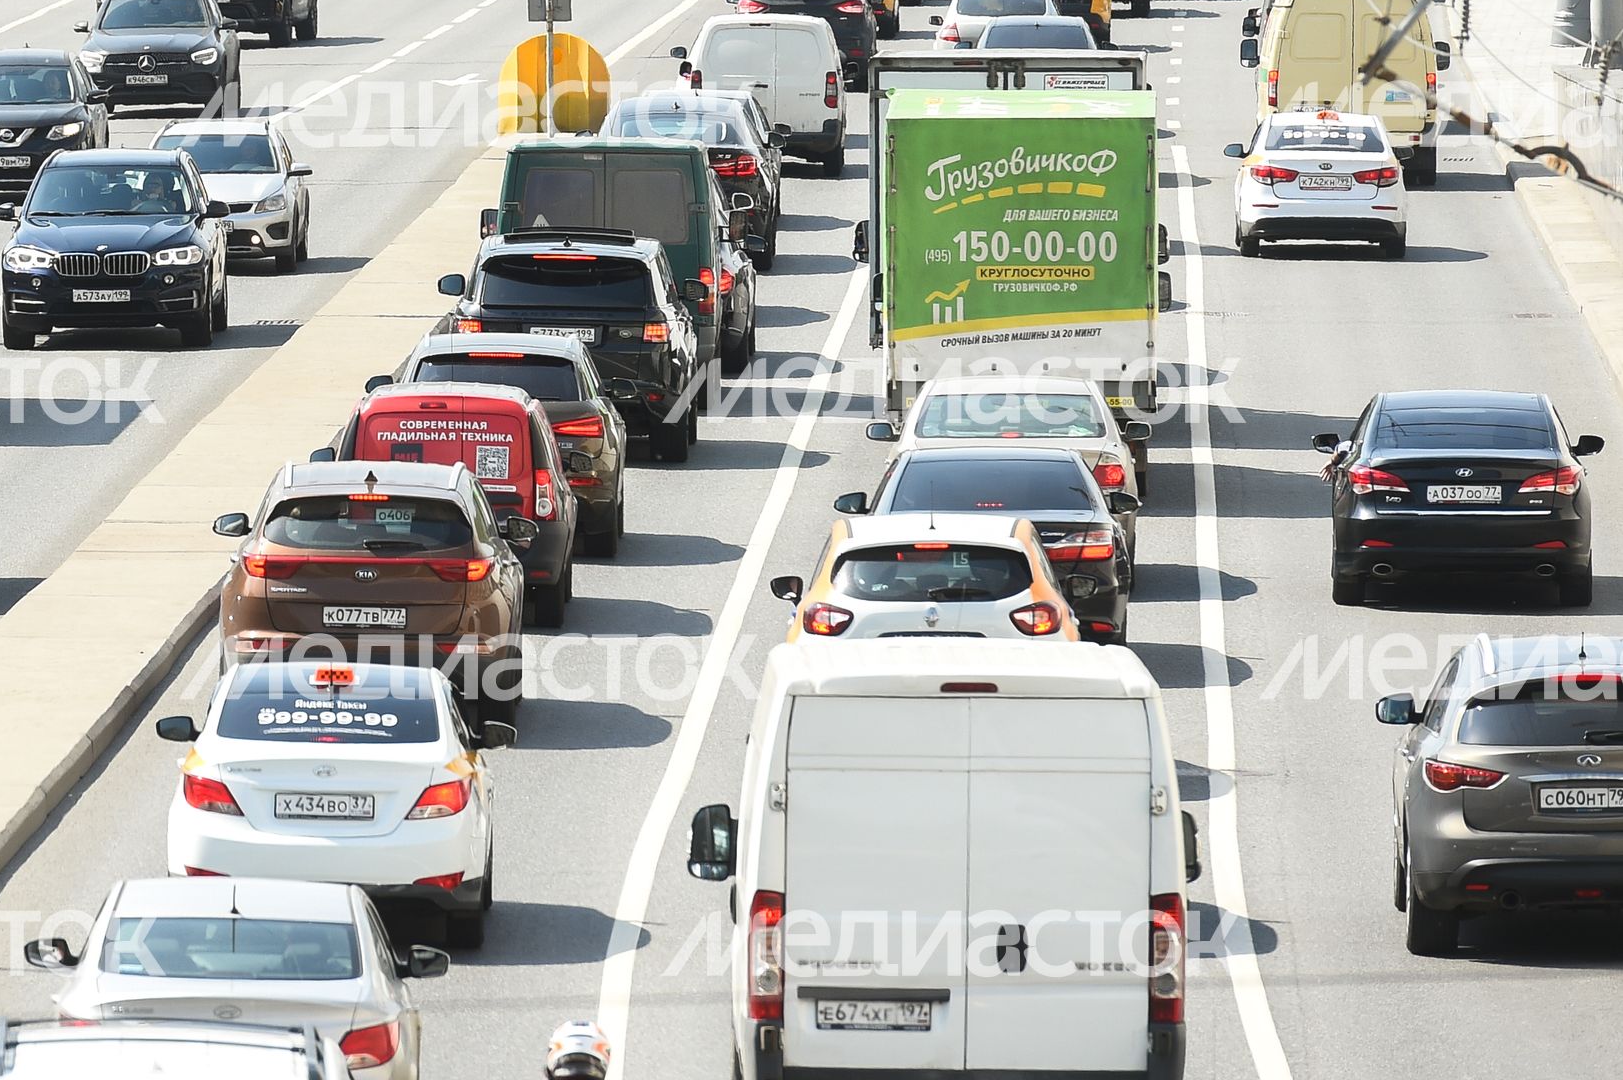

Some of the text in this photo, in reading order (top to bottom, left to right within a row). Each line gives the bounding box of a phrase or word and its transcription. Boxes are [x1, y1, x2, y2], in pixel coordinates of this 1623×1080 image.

[1003, 209, 1119, 223] ДЛЯ ВАШЕГО БИЗНЕСА
[925, 230, 1118, 264] (495) 150-00-00
[980, 268, 1091, 278] КРУГЛОСУТОЧНО
[993, 283, 1078, 293] ГРУЗОВИЧКОФ.РФ
[941, 328, 1102, 348] СРОЧНЫЙ ВЫЗОВ МАШИНЫ ЗА 20 МИНУТ
[400, 421, 488, 430] СОВРЕМЕННАЯ
[378, 432, 514, 442] ГЛАДИЛЬНАЯ ТЕХНИКА
[359, 570, 373, 579] KIA
